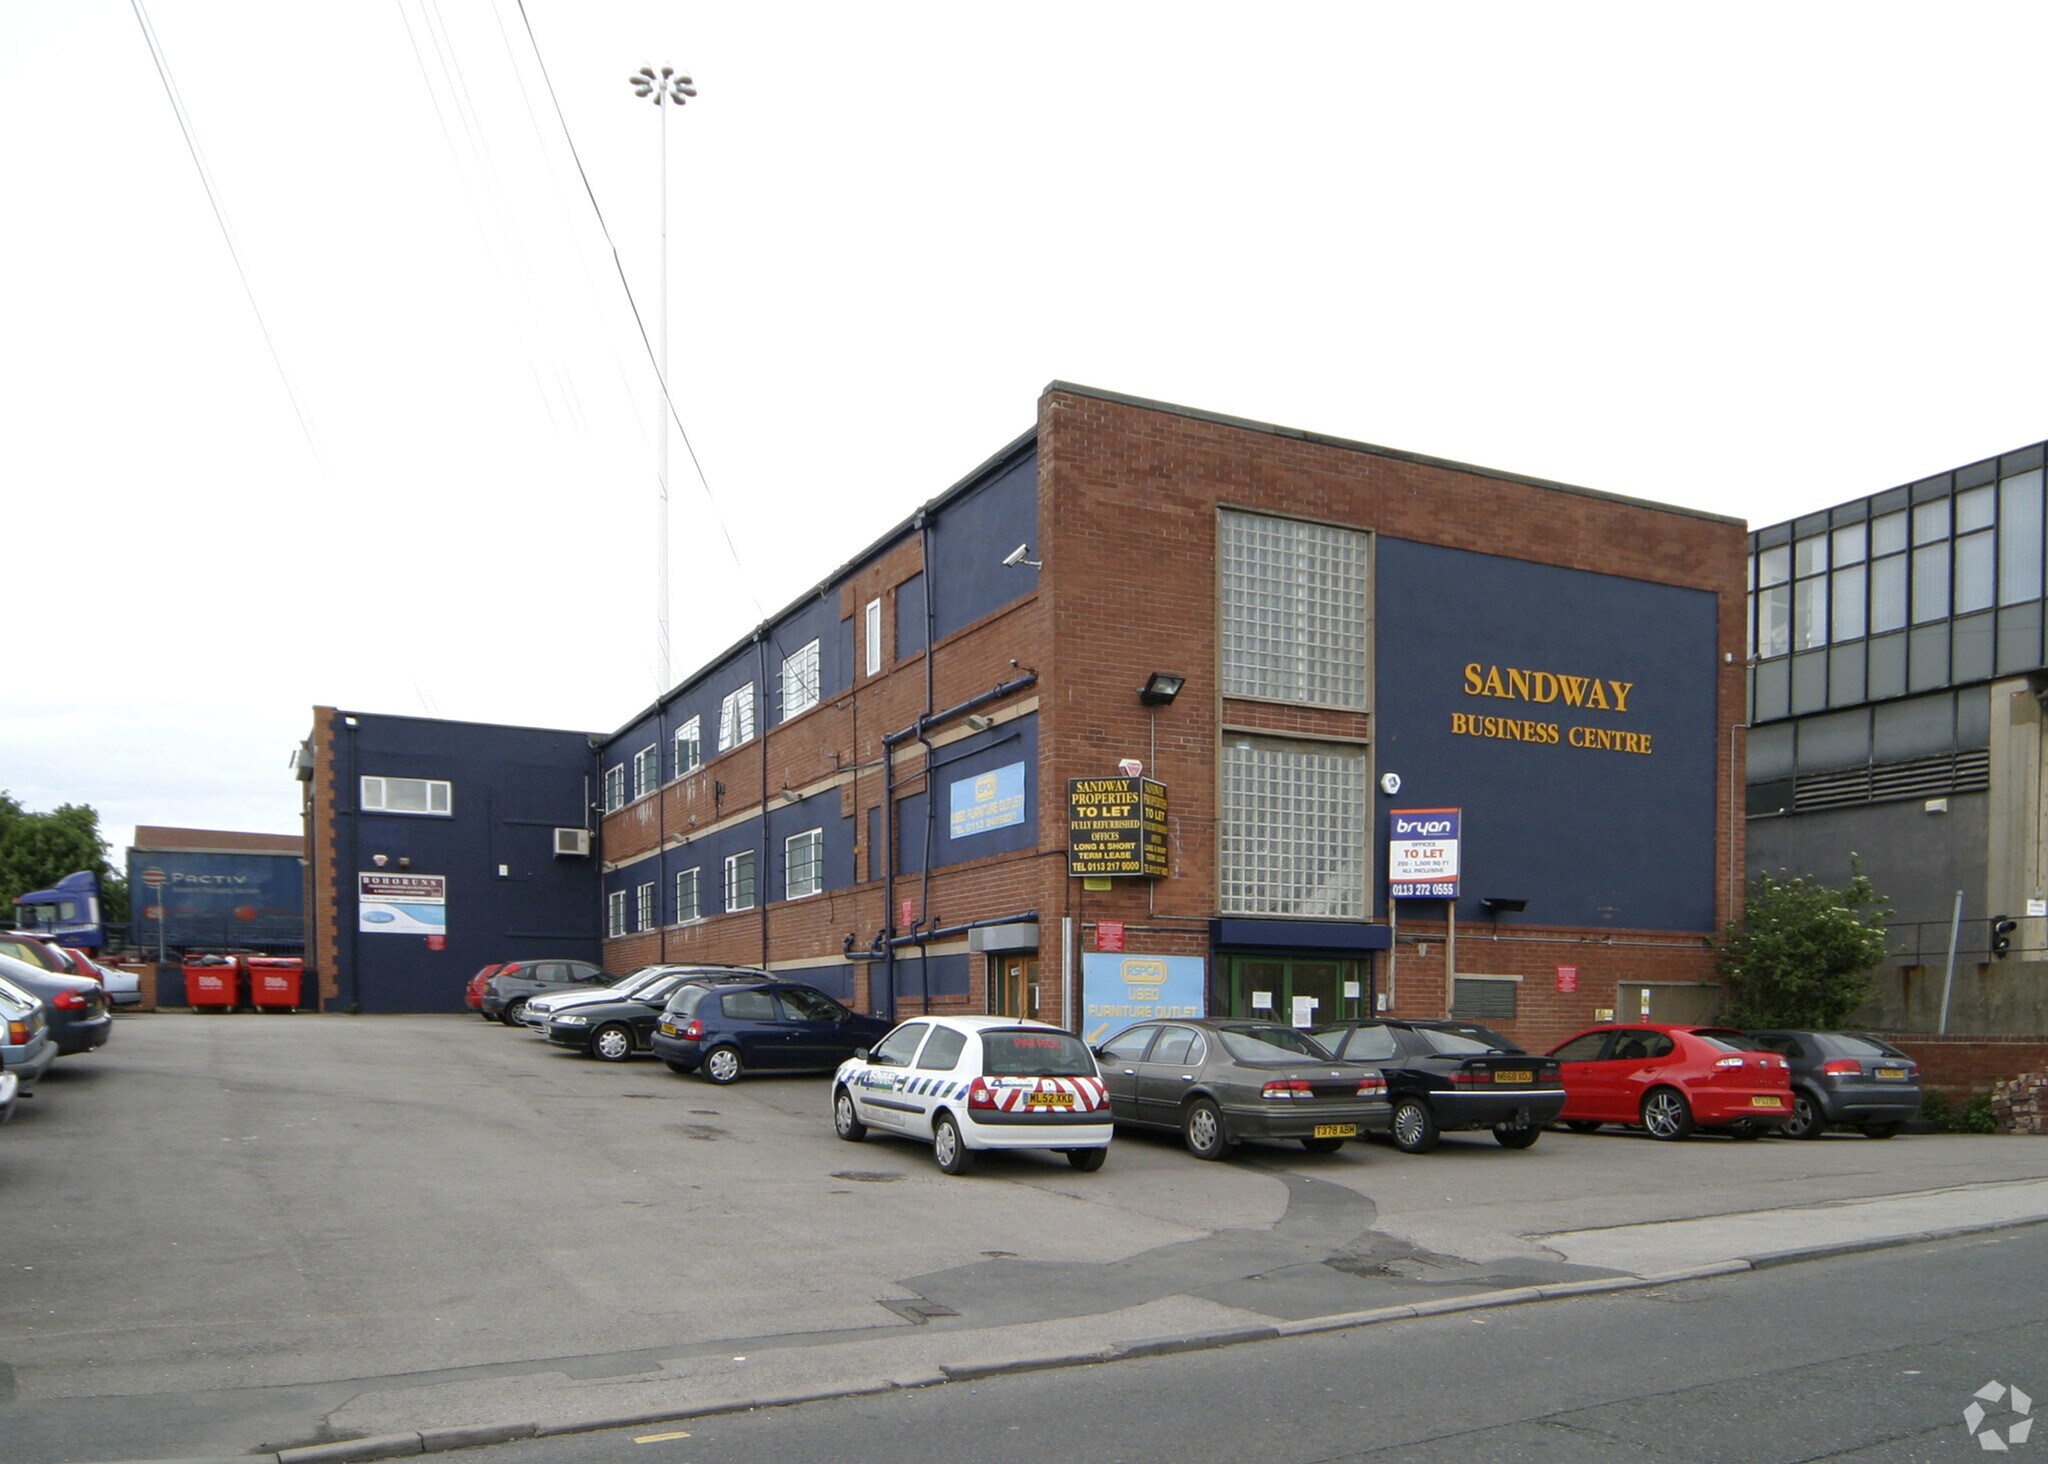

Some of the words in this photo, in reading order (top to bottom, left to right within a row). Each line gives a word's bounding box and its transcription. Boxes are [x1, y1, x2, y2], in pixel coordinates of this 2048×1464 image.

[1464, 662, 1633, 712] SANDWAY
[1451, 712, 1560, 745] BUSINESS
[1568, 726, 1652, 755] CENTRE
[1076, 780, 1130, 793] SANDWAY
[1071, 792, 1139, 805] PROPERTIES
[1076, 806, 1098, 818] TO
[1102, 805, 1131, 817] LET
[1145, 807, 1154, 819] TO
[1154, 810, 1165, 822] LET
[1071, 820, 1092, 830] FULLY
[1092, 819, 1140, 829] REFURBISHED
[1396, 818, 1451, 836] bryan
[1091, 832, 1120, 841] OFFICES
[1073, 843, 1097, 851] LONG
[1107, 842, 1136, 850] SHORT
[1078, 852, 1102, 860] TERM
[1104, 851, 1131, 859] LEASE
[1403, 849, 1419, 859] TO
[1423, 848, 1445, 858] LET
[1072, 862, 1086, 871] TEL
[1087, 862, 1106, 871] 0113
[1106, 862, 1120, 871] 217
[362, 876, 437, 886] BOHORUNS
[1392, 884, 1414, 896] 0113
[1415, 884, 1431, 896] 272
[1432, 883, 1454, 895] 0555
[1127, 965, 1162, 977] RSPCA
[1128, 988, 1159, 1001] USED
[1088, 1004, 1152, 1018] FURNITURE
[1155, 1005, 1198, 1018] OUTLET
[1013, 1037, 1063, 1049] PATROL
[1029, 1093, 1055, 1104] ML52
[1056, 1093, 1074, 1103] XKD
[1316, 1126, 1337, 1137] T378
